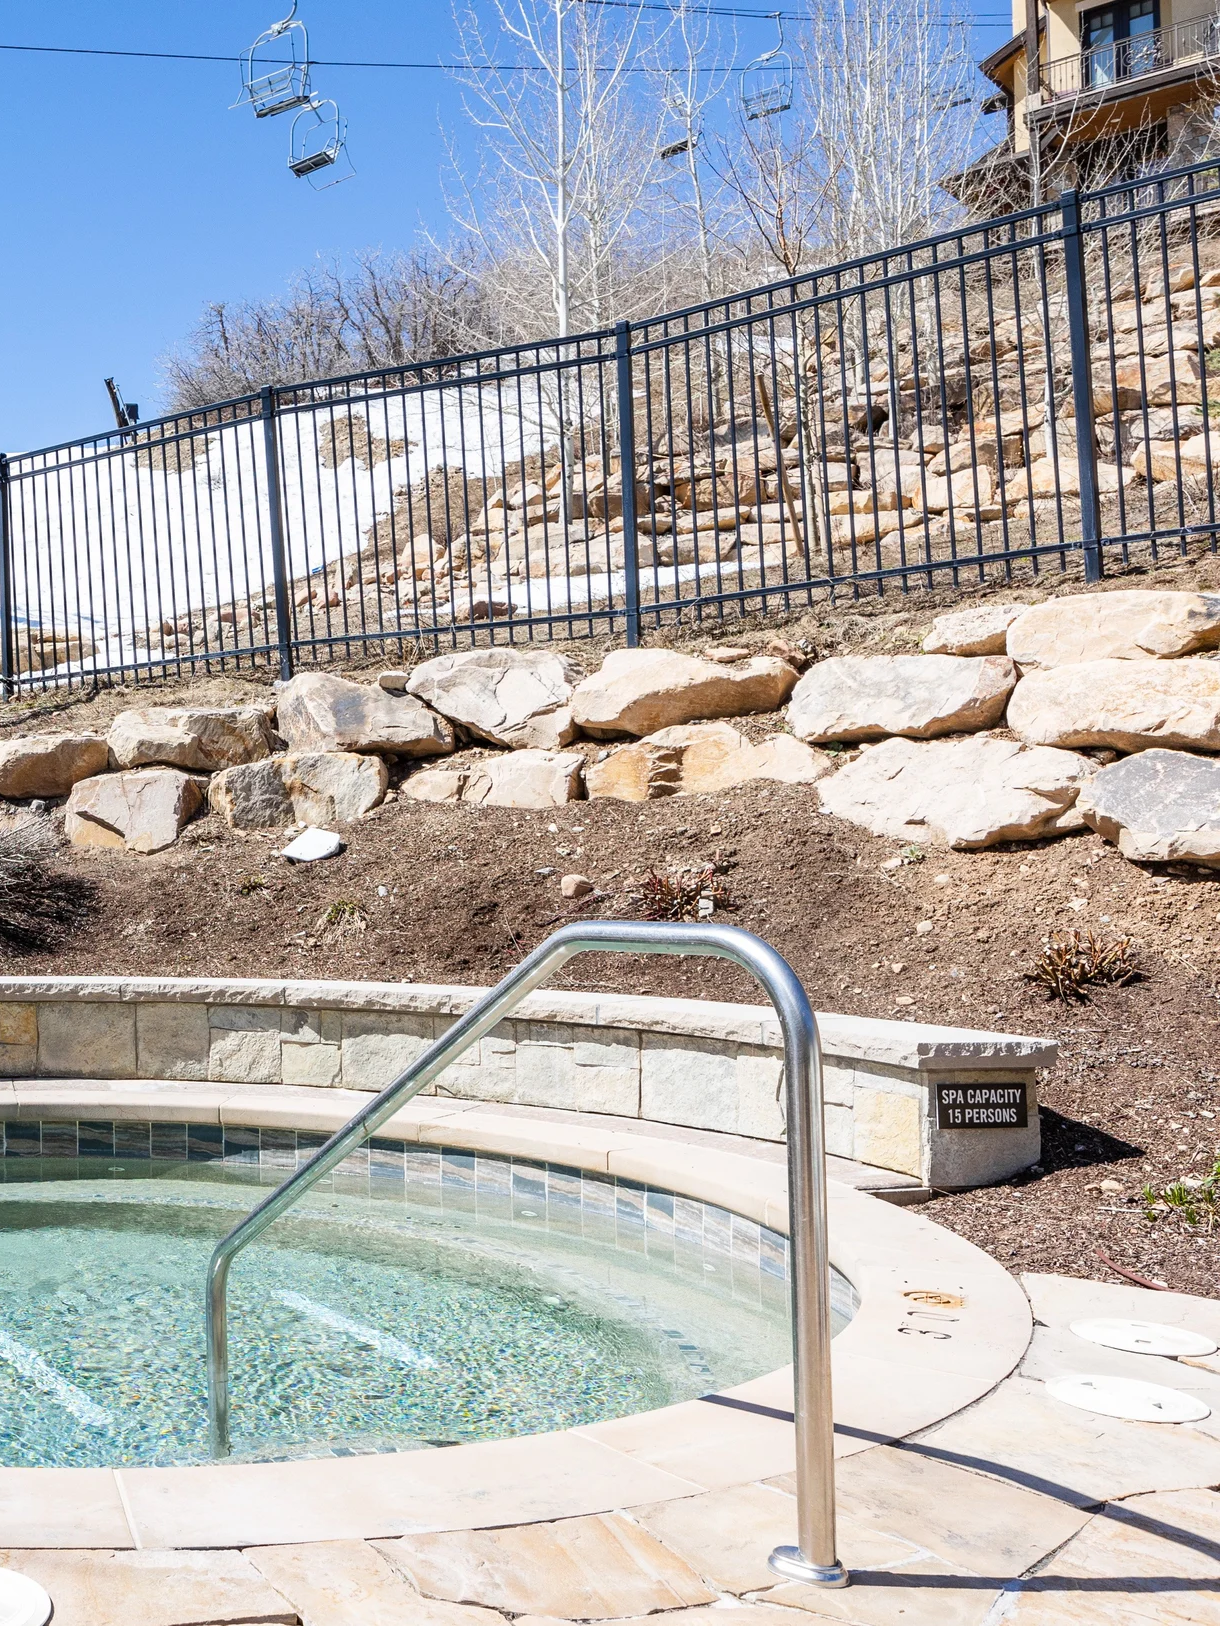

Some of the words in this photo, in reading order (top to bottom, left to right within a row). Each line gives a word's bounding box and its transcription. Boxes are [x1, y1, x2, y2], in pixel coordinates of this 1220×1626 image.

[942, 1089, 964, 1104] SPA
[967, 1089, 1022, 1104] CAPACITY
[948, 1109, 962, 1123] 15
[965, 1108, 1017, 1123] PERSONS
